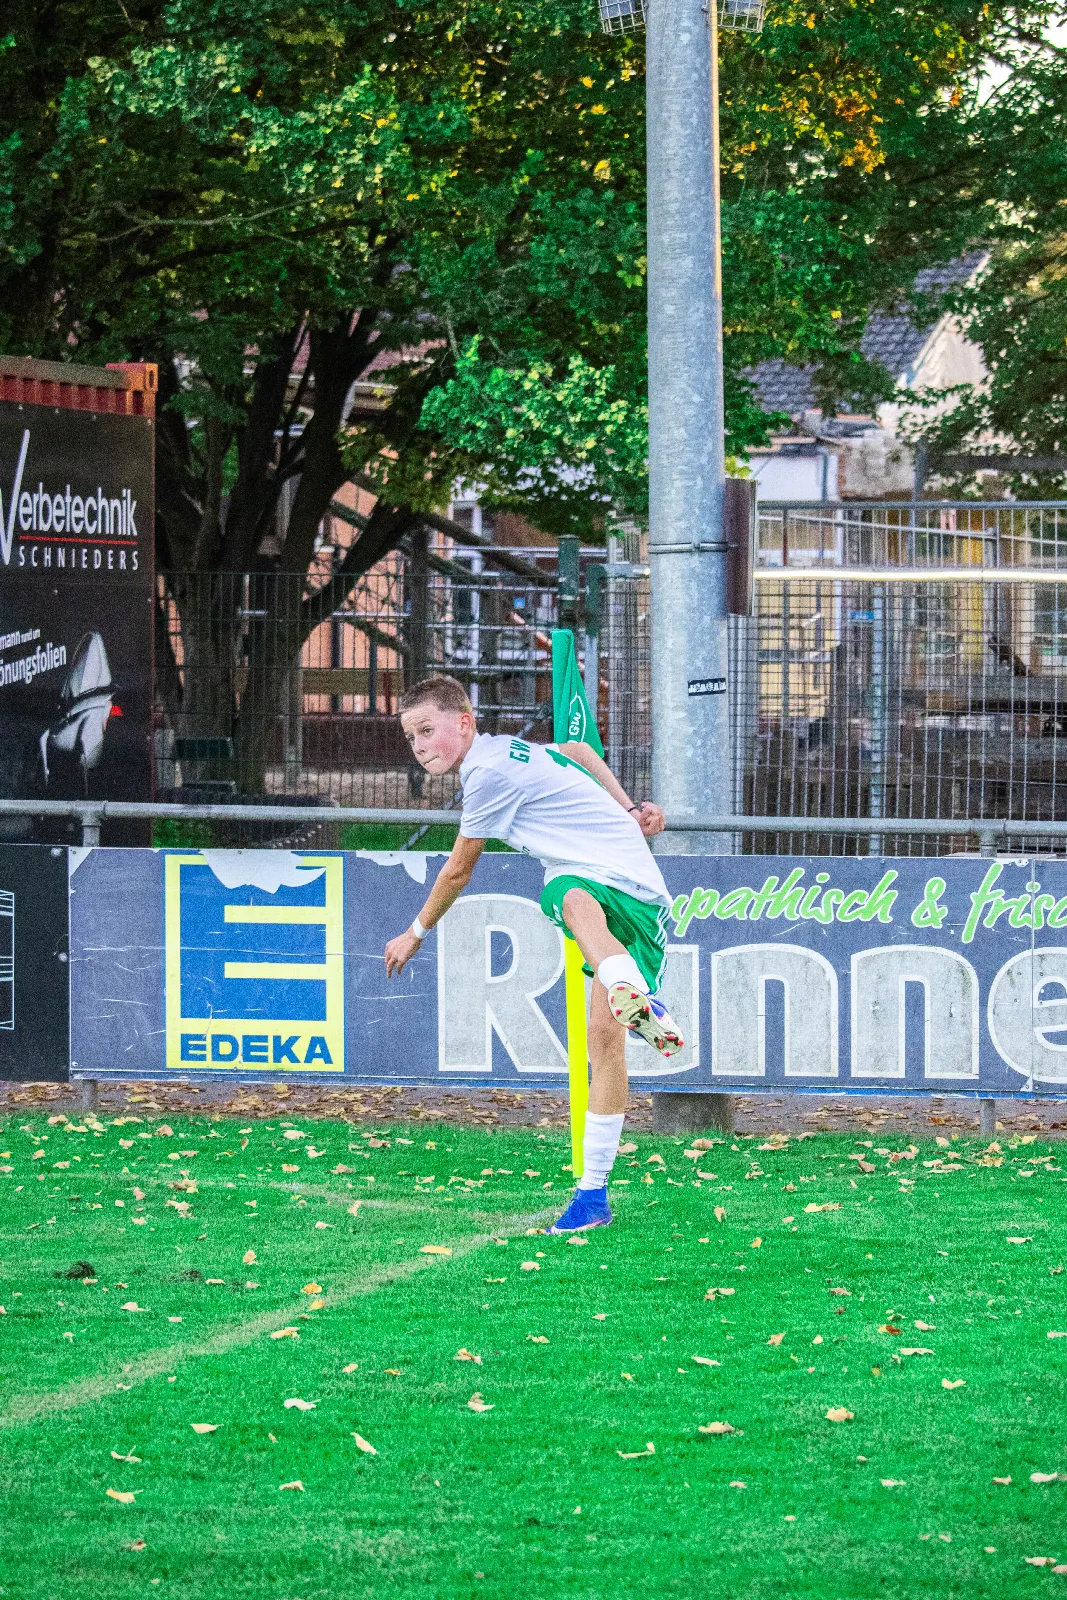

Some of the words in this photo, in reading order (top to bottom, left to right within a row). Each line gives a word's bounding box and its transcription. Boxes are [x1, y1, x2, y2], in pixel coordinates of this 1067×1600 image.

[18, 545, 139, 571] SCHNIEDERS
[568, 711, 582, 736] GW
[509, 739, 531, 764] GW
[911, 876, 948, 928] &
[180, 1034, 333, 1064] EDEKA
